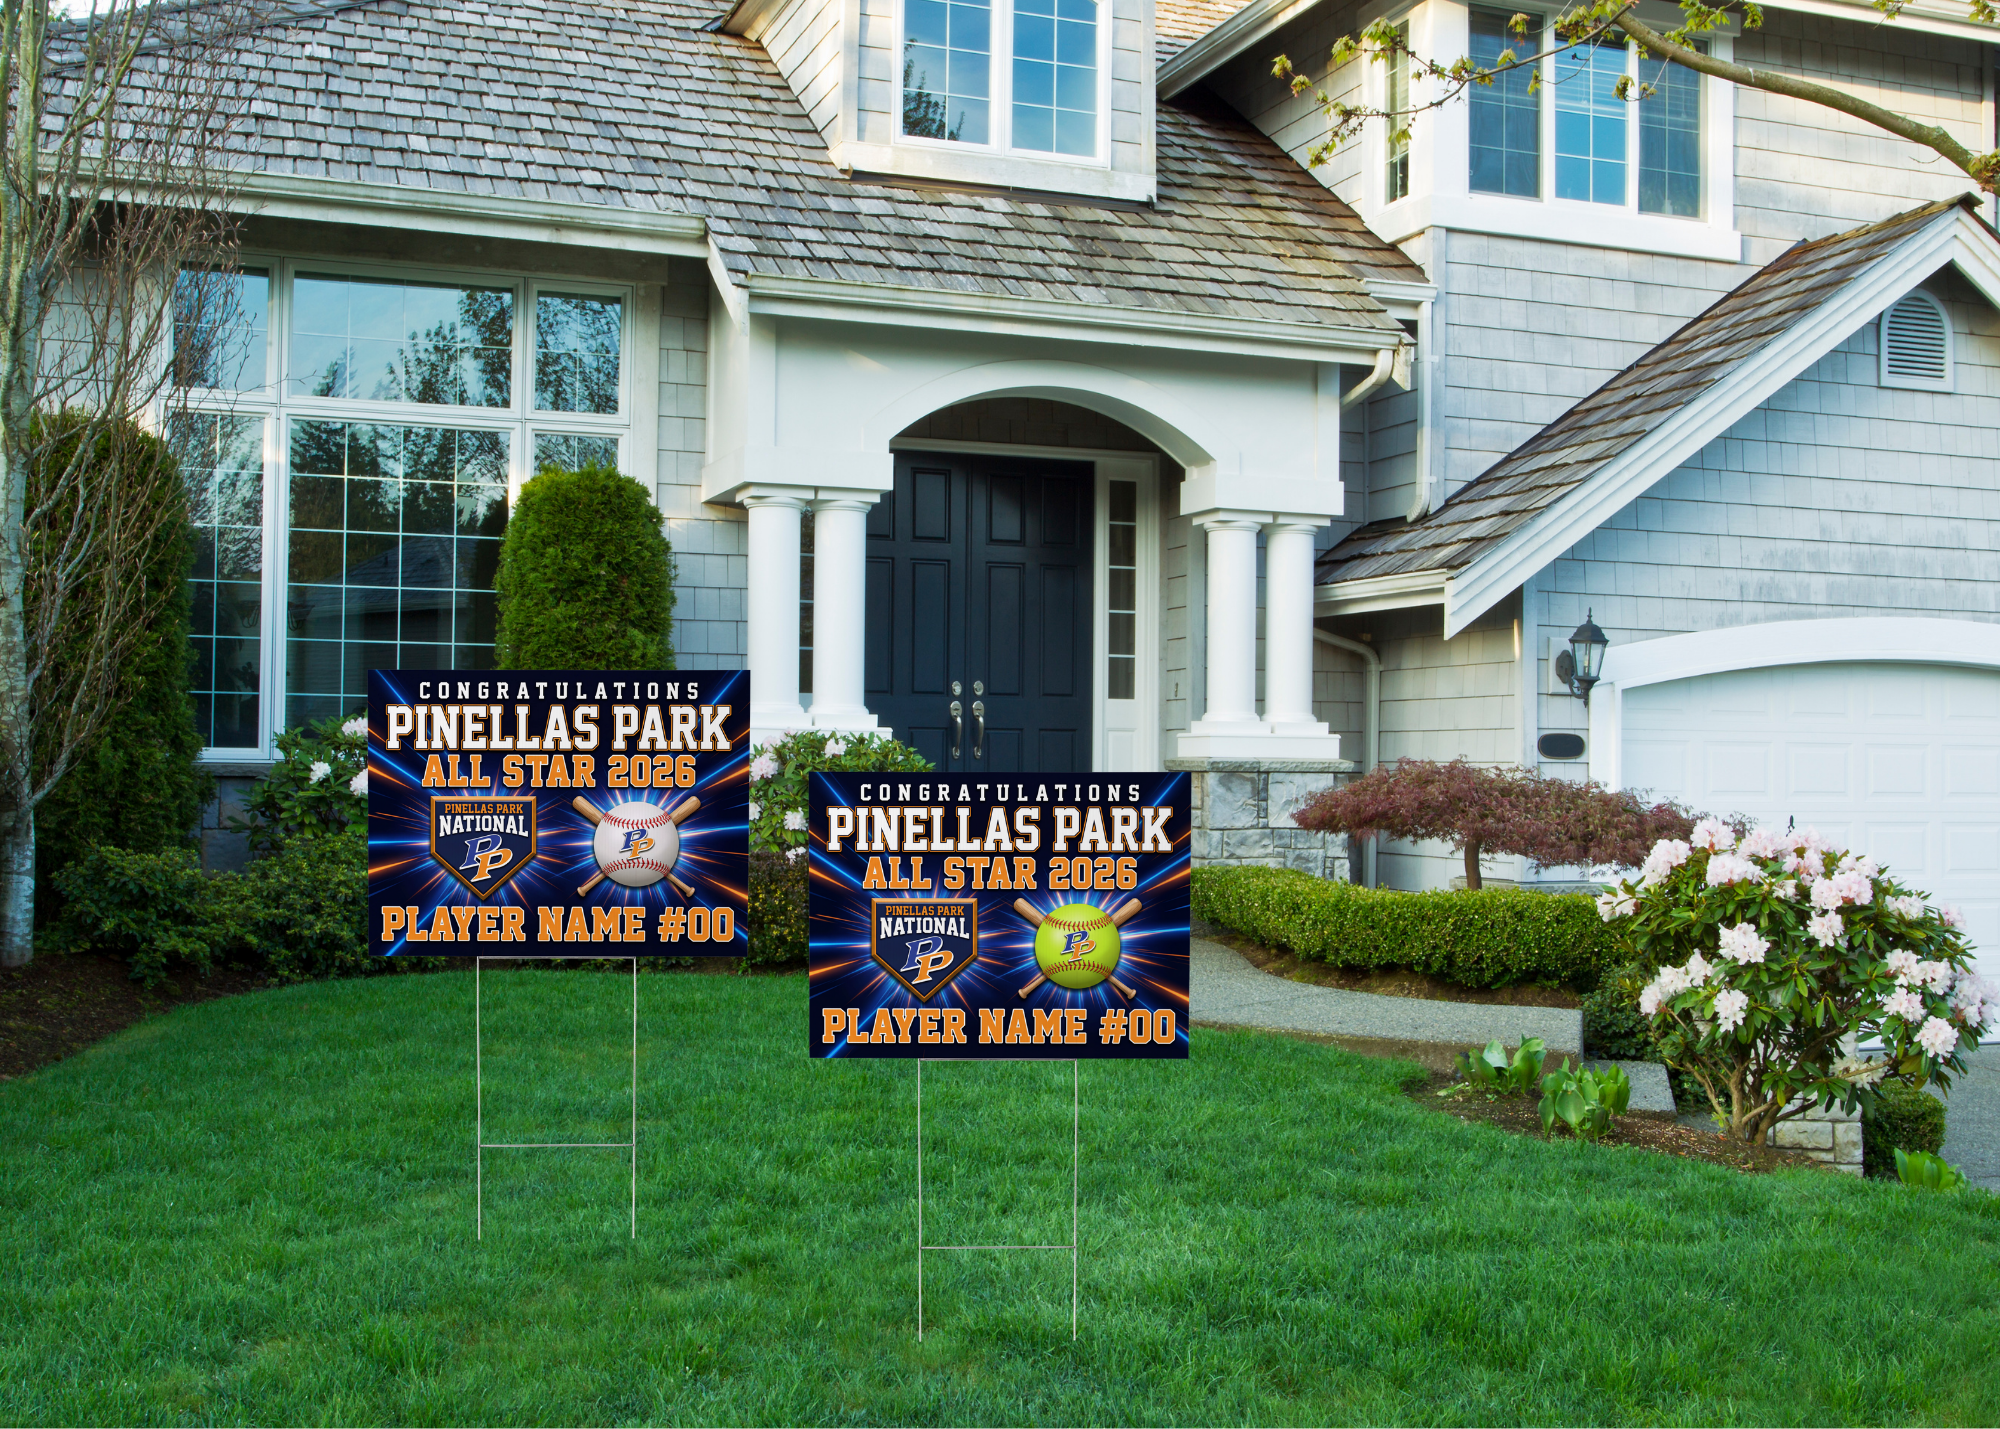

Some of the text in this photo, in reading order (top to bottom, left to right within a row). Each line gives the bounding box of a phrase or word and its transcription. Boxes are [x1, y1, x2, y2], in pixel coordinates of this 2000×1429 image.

[419, 682, 699, 699] CONGRATULATIONS
[386, 704, 732, 751] PINELLAS PARK
[422, 755, 696, 788] ALL STAR 2026
[861, 784, 1140, 802] CONGRATULATIONS
[445, 803, 523, 814] PINELLAS PARK
[439, 815, 528, 838] NATIONAL
[827, 806, 1173, 853] PINELLAS PARK
[862, 857, 1138, 889] ALL STAR 2026
[382, 906, 734, 942] PLAYER NAME #00
[886, 905, 964, 916] PINELLAS PARK
[880, 917, 969, 939] NATIONAL
[822, 1008, 1176, 1044] PLAYER NAME #00
